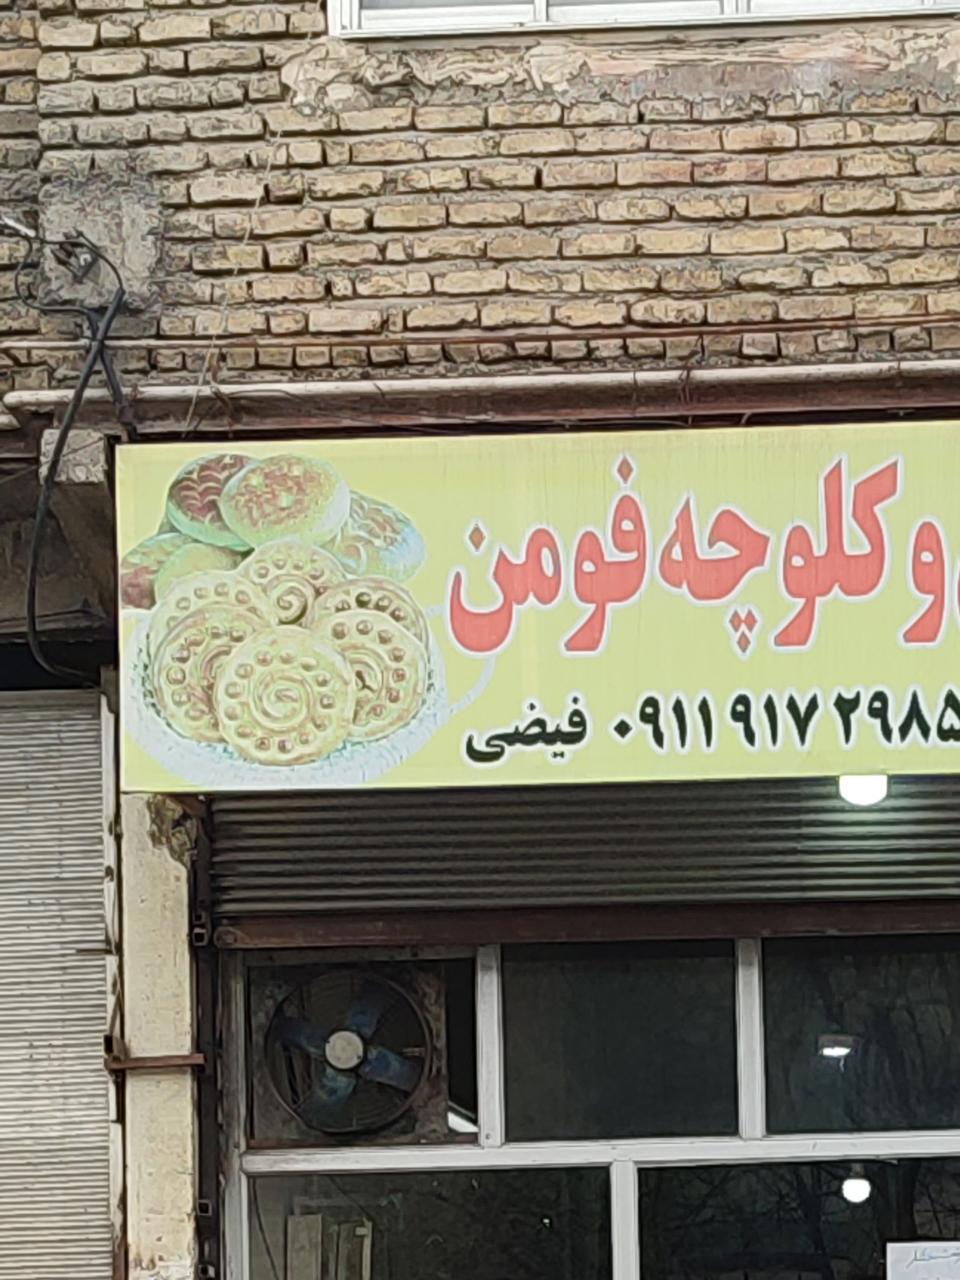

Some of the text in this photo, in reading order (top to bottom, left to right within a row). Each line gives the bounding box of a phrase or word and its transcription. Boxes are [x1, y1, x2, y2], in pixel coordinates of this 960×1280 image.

[448, 455, 647, 653] فومن
[659, 456, 898, 655] کلوچه
[903, 522, 946, 644] و
[466, 697, 587, 763] فیضی
